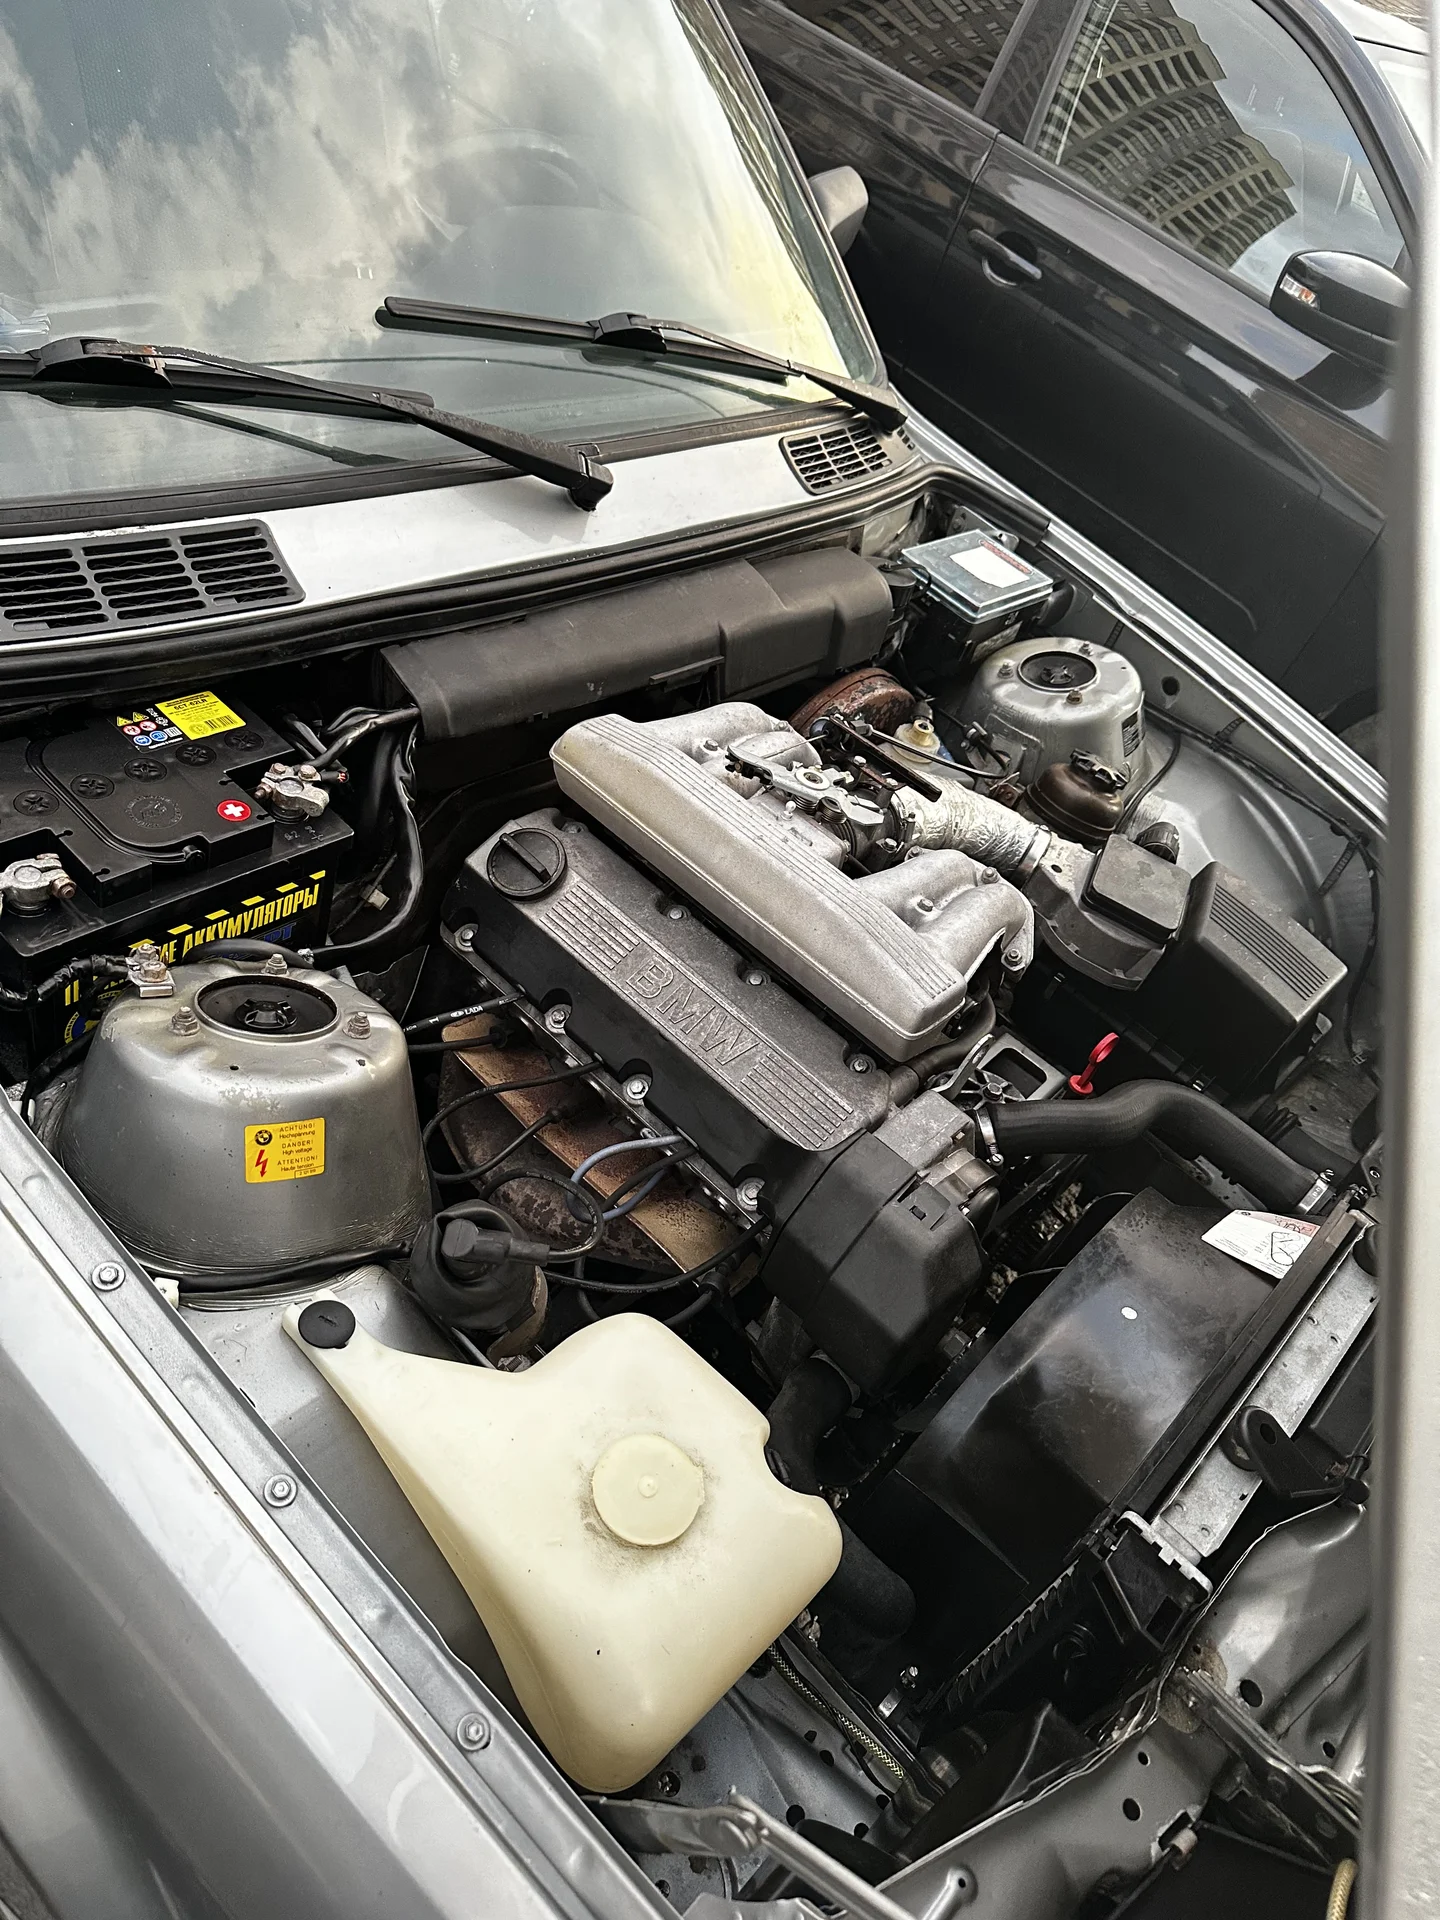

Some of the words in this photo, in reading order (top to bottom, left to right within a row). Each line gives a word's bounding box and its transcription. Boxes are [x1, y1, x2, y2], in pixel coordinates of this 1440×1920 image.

[182, 884, 319, 958] АККУМУЛЯТОРЫ
[464, 1005, 484, 1015] LADA
[626, 954, 759, 1066] BMW
[279, 1122, 315, 1132] ACHTUNG!
[282, 1140, 313, 1149] DANGER!
[277, 1155, 318, 1165] ATTENTION!
